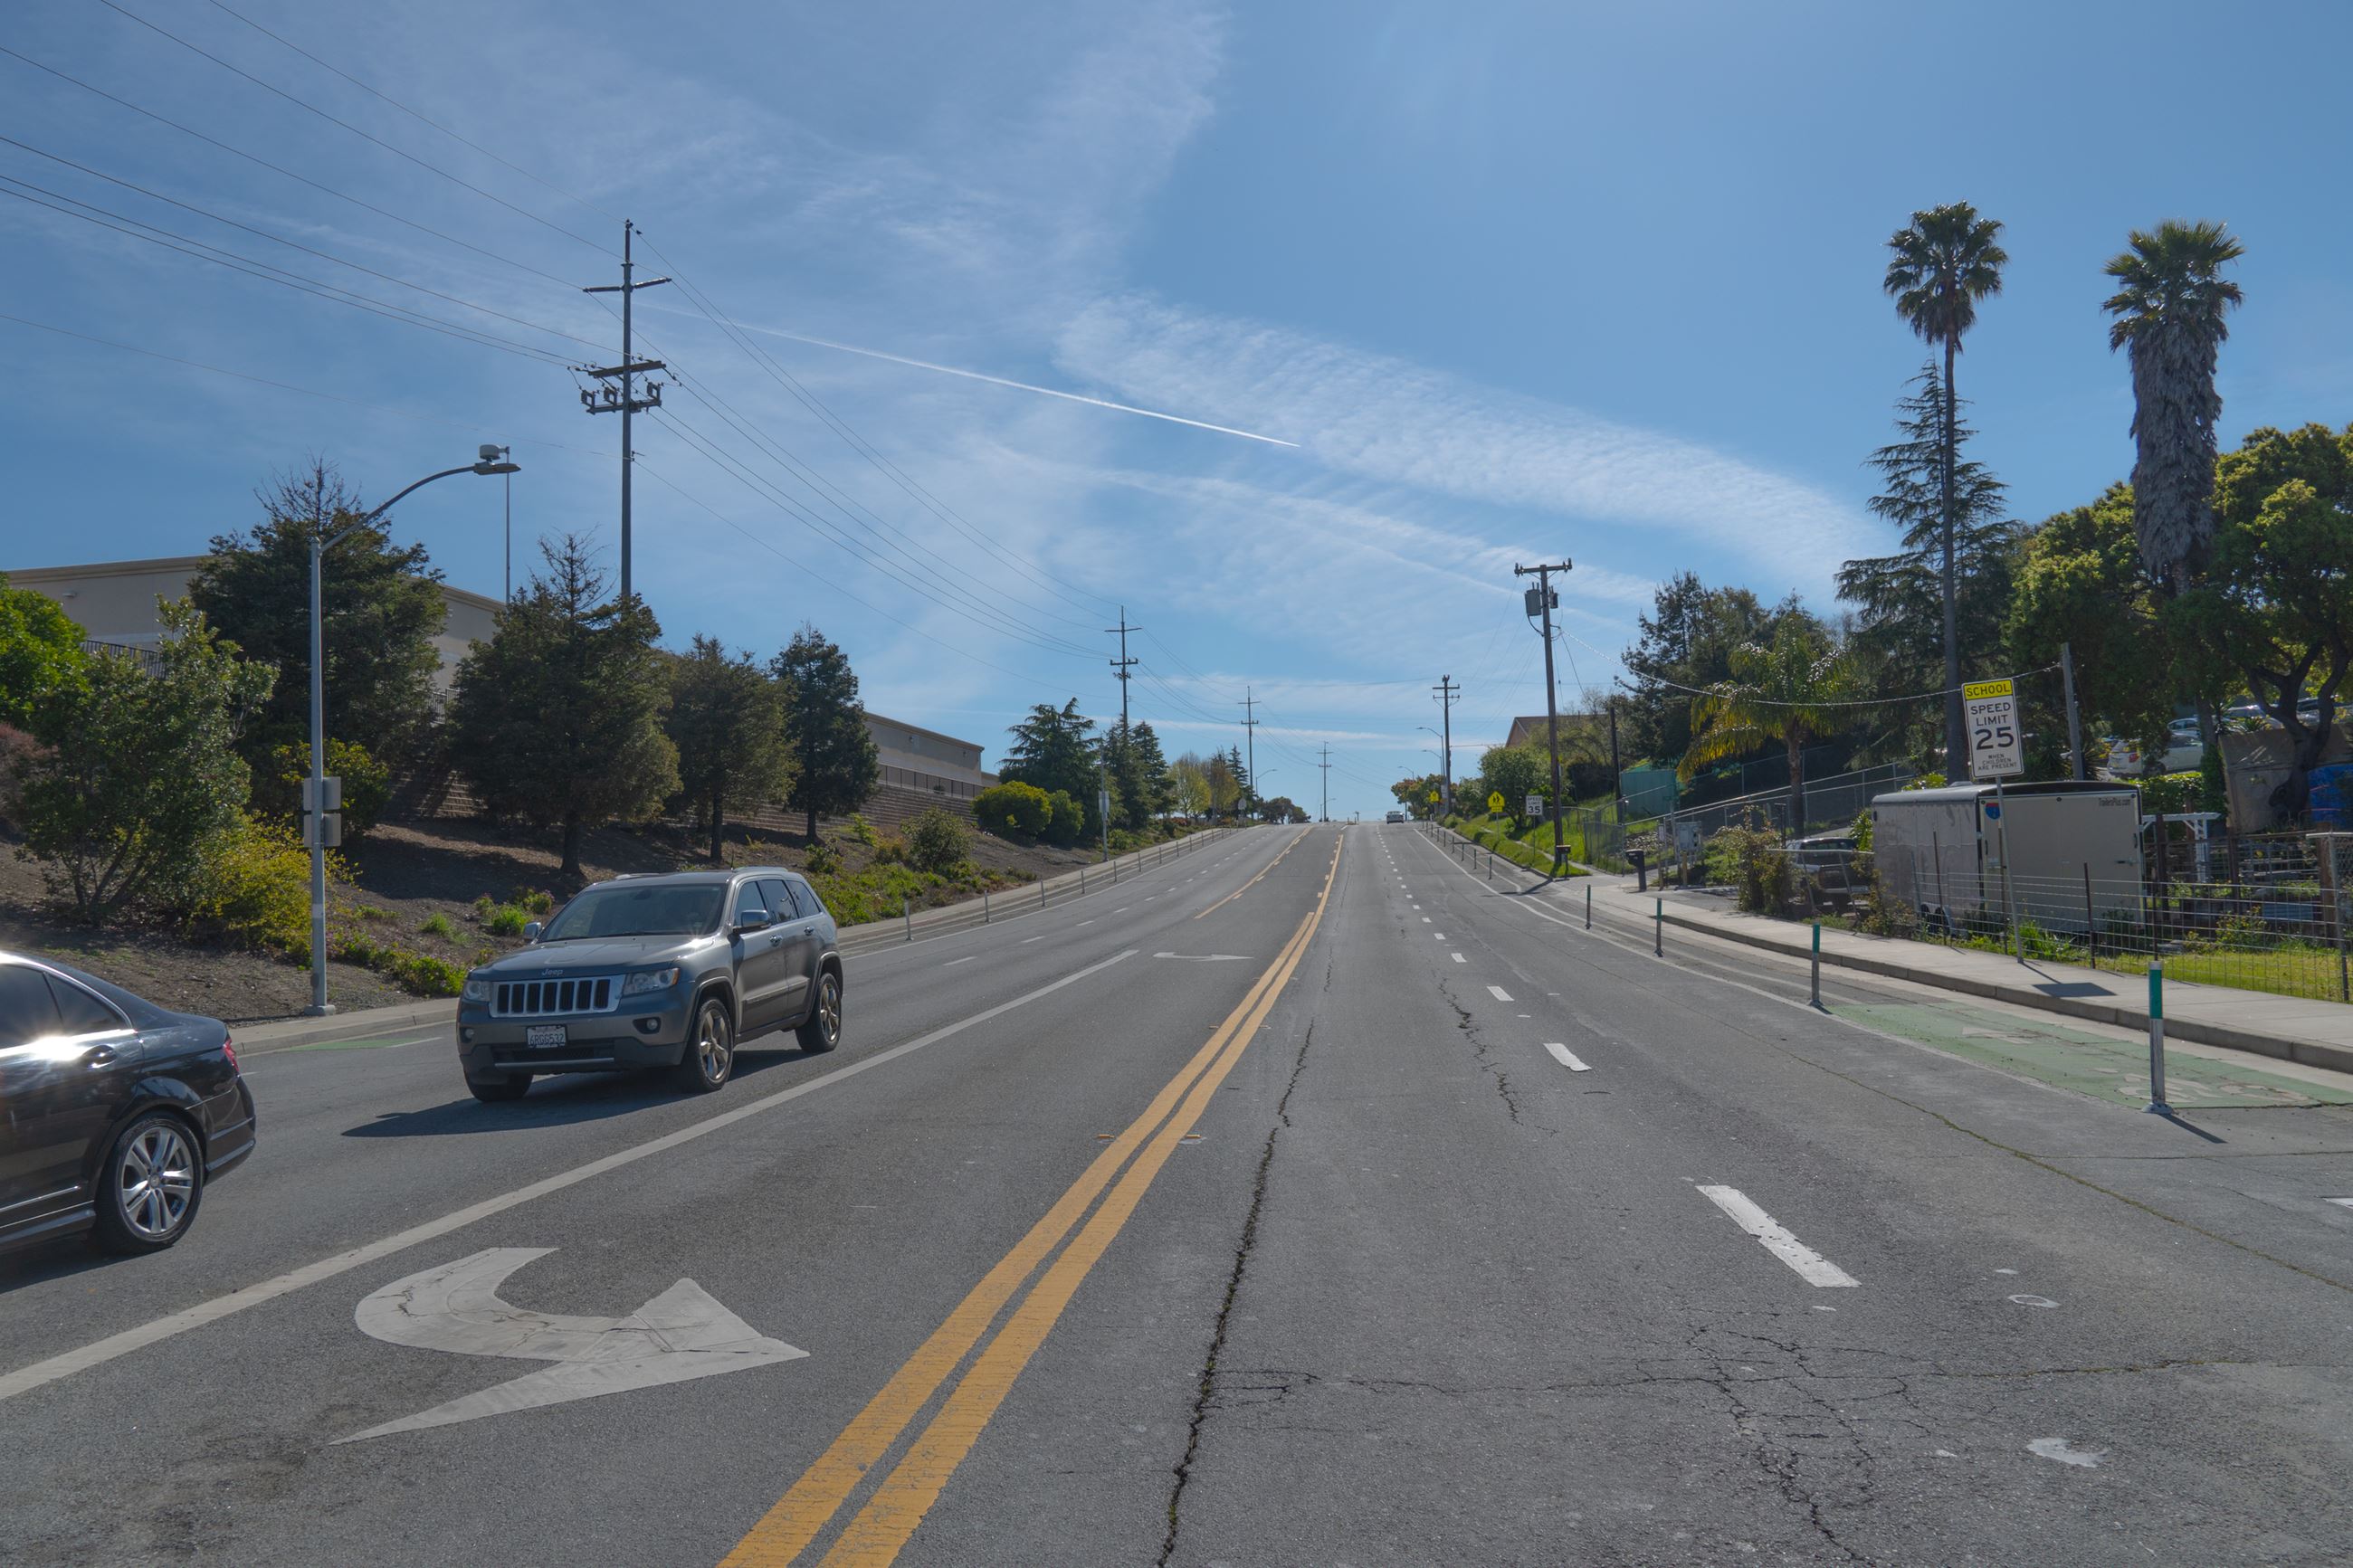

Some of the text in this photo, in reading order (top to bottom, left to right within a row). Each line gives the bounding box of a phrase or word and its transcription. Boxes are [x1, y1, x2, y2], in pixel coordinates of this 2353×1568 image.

[1967, 684, 2010, 697] SCHOOL
[1971, 702, 2011, 715] SPEED
[1977, 715, 2008, 727] LIMIT
[1975, 727, 2015, 750] 25
[1982, 757, 2012, 765] CHILDREN
[1991, 761, 2017, 769] PRESENT
[1528, 805, 1541, 813] 35
[541, 968, 564, 976] Jeep
